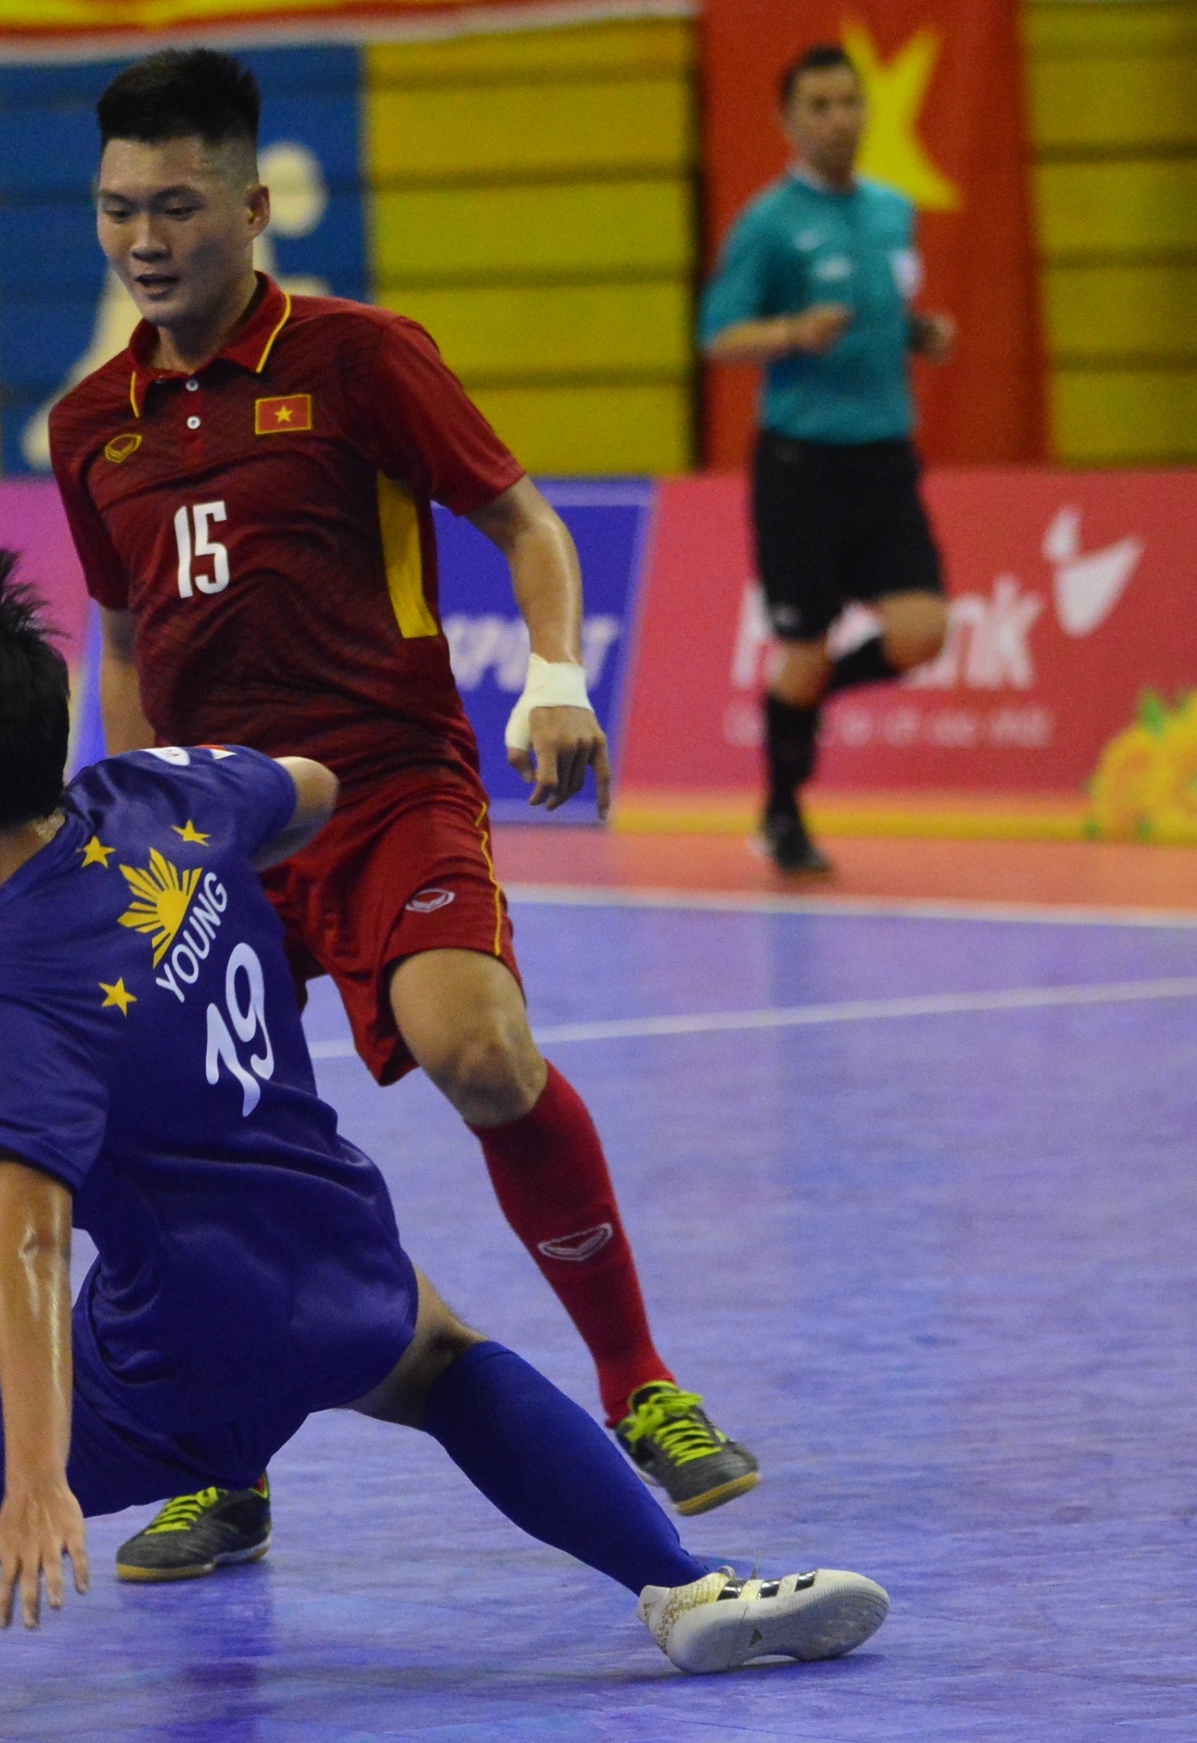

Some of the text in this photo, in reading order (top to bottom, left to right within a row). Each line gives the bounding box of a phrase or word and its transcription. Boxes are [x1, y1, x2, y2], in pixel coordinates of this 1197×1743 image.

[173, 500, 231, 599] 15
[155, 871, 229, 1003] YOUNG
[205, 941, 275, 1118] 19
